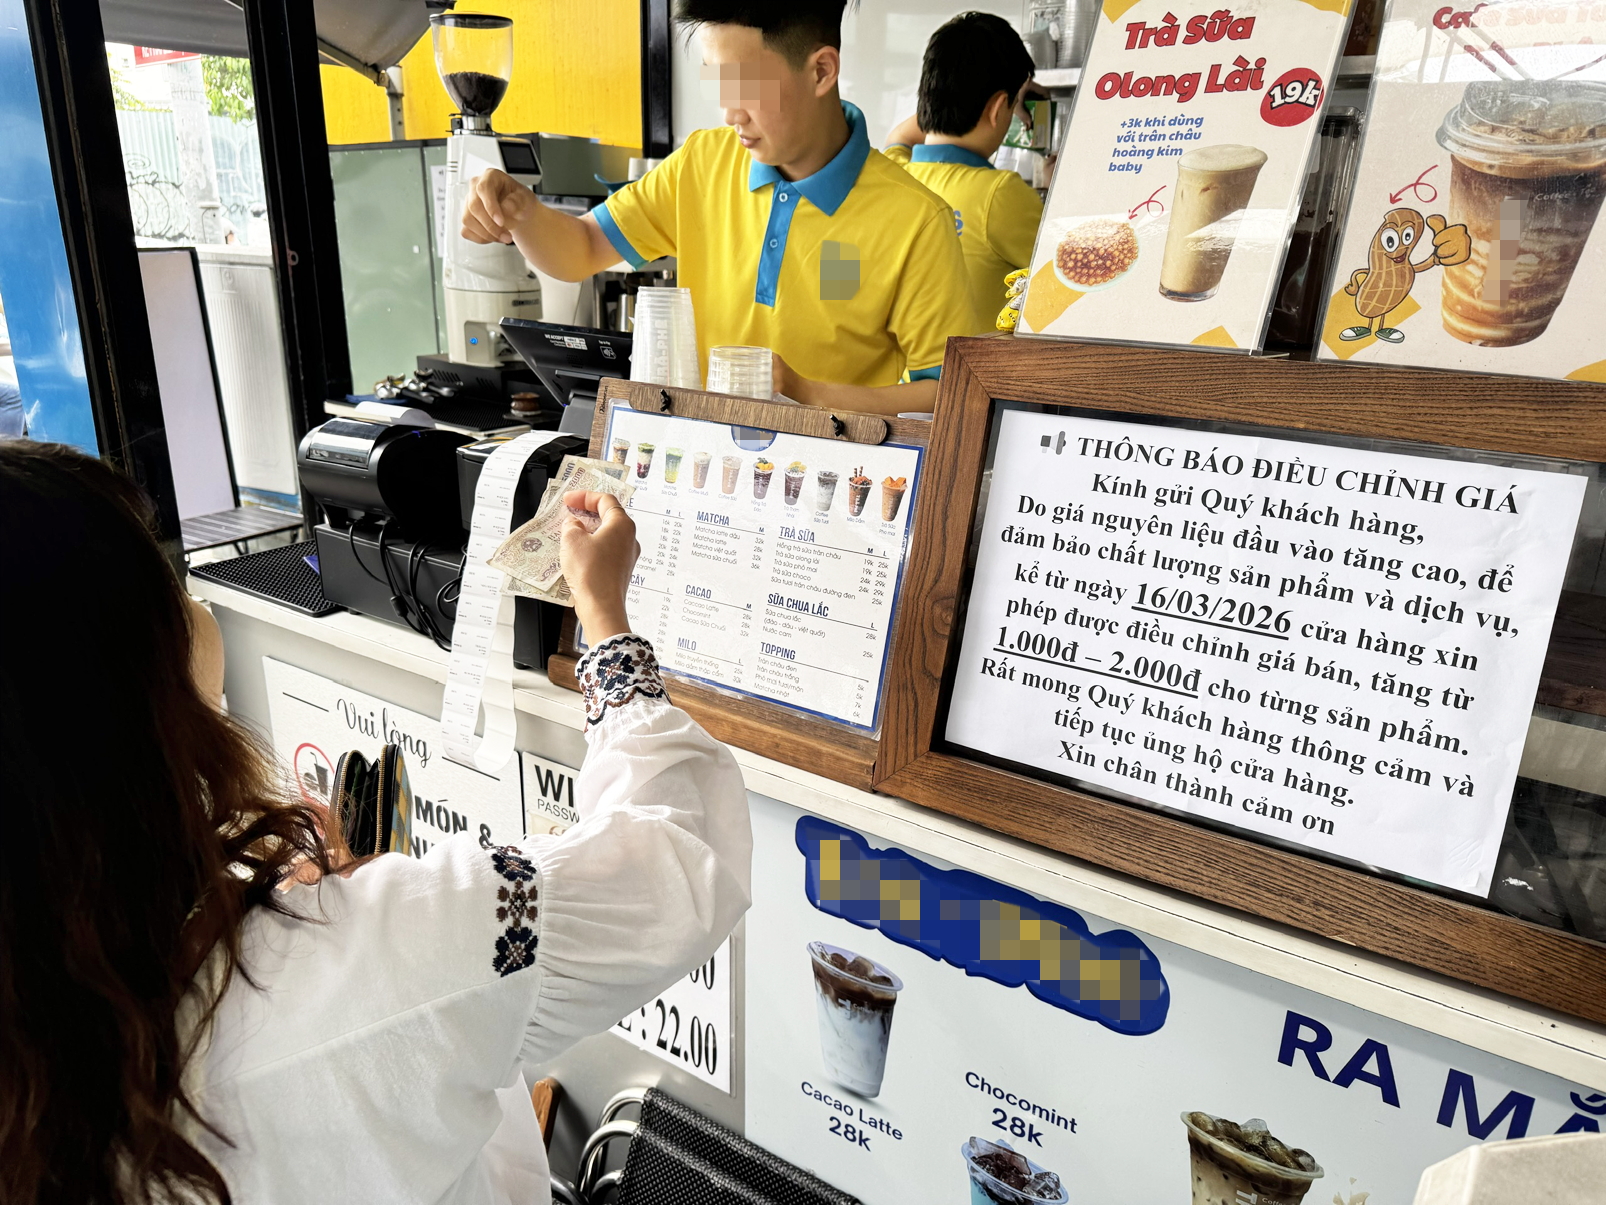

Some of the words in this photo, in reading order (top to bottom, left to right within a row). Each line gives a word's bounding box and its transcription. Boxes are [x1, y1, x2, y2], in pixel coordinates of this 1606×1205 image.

[1125, 11, 1180, 50] Trà
[1182, 9, 1256, 45] Sữa
[1094, 68, 1202, 103] Olong
[1204, 55, 1267, 94] Lài
[1269, 78, 1321, 110] 19k
[1117, 130, 1138, 143] với
[1138, 131, 1166, 143] trân
[1168, 129, 1202, 142] châu
[1120, 117, 1142, 129] +3k
[1144, 114, 1166, 128] khi
[1167, 113, 1204, 130] dùng
[1108, 161, 1143, 174] baby
[1112, 145, 1155, 160] hoàng
[1156, 145, 1183, 157] kim
[1078, 436, 1175, 467] THÔNG
[1182, 446, 1244, 476] BÁO
[1251, 457, 1329, 487] ĐIỀU
[1336, 469, 1447, 504] CHỈNH
[1455, 484, 1519, 515] GIÁ
[696, 510, 730, 526] MATCHA
[1091, 473, 1147, 499] Kính
[1153, 484, 1194, 508] gửi
[1201, 489, 1254, 519] Quý
[1261, 497, 1339, 527] khách
[1349, 510, 1424, 545] hàng,
[780, 526, 796, 540] TRÀ
[797, 528, 815, 543] SỮA
[1017, 495, 1046, 517] Do
[1052, 503, 1084, 525] giá
[1091, 512, 1173, 537] nguyên
[1181, 520, 1224, 548] liệu
[1233, 524, 1279, 554] đầu
[1289, 539, 1334, 563] vào
[1343, 548, 1404, 581] tăng
[1412, 563, 1467, 591] cao,
[1478, 564, 1515, 593] để
[630, 572, 646, 586] CÂY
[860, 576, 871, 585] 24k
[874, 579, 886, 588] 29k
[862, 567, 873, 576] 19k
[876, 570, 887, 579] 25k
[864, 558, 874, 567] 19k
[877, 561, 889, 570] 25k
[1001, 525, 1045, 549] đảm
[1052, 533, 1091, 556] bảo
[1098, 540, 1147, 566] chất
[1152, 550, 1223, 585] lượng
[1229, 565, 1271, 589] sản
[1278, 572, 1354, 604] phẩm
[1365, 589, 1394, 612] và
[1404, 595, 1464, 624] dịch
[1476, 612, 1519, 639] vụ,
[685, 584, 712, 599] CACAO
[767, 592, 784, 607] SỮA
[786, 597, 809, 613] CHUA
[811, 601, 829, 618] LẮC
[858, 585, 869, 594] 24k
[873, 588, 884, 597] 29k
[741, 621, 751, 629] 28k
[1014, 561, 1040, 584] kể
[1045, 570, 1069, 590] từ
[1074, 579, 1128, 606] ngày
[1136, 583, 1293, 635] 16/03/2026
[1301, 621, 1347, 645] cửa
[1356, 628, 1426, 666] hàng
[1433, 647, 1478, 672] xin
[677, 637, 697, 651] MILO
[760, 641, 796, 661] TOPPING
[865, 632, 877, 641] 28k
[1005, 597, 1057, 626] phép
[1064, 607, 1119, 636] được
[1126, 619, 1174, 647] điều
[1182, 633, 1249, 663] chỉnh
[1257, 650, 1296, 673] giá
[1305, 656, 1360, 692] bán,
[1371, 672, 1433, 708] tăng
[1442, 687, 1475, 711] từ
[997, 626, 1079, 663] 1.000đ
[1109, 651, 1203, 692] 2.000đ
[1208, 679, 1251, 704] cho
[1260, 690, 1320, 726] từng
[1326, 707, 1371, 733] sản
[1378, 719, 1468, 756] phẩm.
[337, 698, 379, 739] Vui
[383, 708, 432, 768] lòng
[980, 657, 1016, 682] Rất
[1022, 672, 1082, 703] mong
[1088, 685, 1135, 716] Quý
[1141, 697, 1212, 732] khách
[1221, 716, 1284, 755] hàng
[1292, 736, 1367, 776] thông
[1375, 758, 1431, 787] cảm
[1443, 774, 1474, 798] và
[1054, 707, 1094, 738] tiếp
[1102, 722, 1136, 746] tục
[1143, 731, 1187, 764] ủng
[1193, 744, 1222, 774] hộ
[1230, 758, 1274, 783] cửa
[1283, 767, 1354, 808] hàng.
[534, 764, 574, 808] WI
[1057, 740, 1096, 768] Xin
[1103, 756, 1157, 785] chân
[1166, 773, 1233, 807] thành
[1242, 797, 1293, 824] cảm
[1302, 815, 1334, 836] ơn
[655, 998, 717, 1075] 22.00
[1277, 1009, 1401, 1109] RA
[800, 1081, 854, 1117] Cacao
[859, 1108, 903, 1141] Latte
[965, 1071, 1078, 1134] Chocomint
[829, 1116, 871, 1152] 28k
[992, 1108, 1043, 1148] 28k
